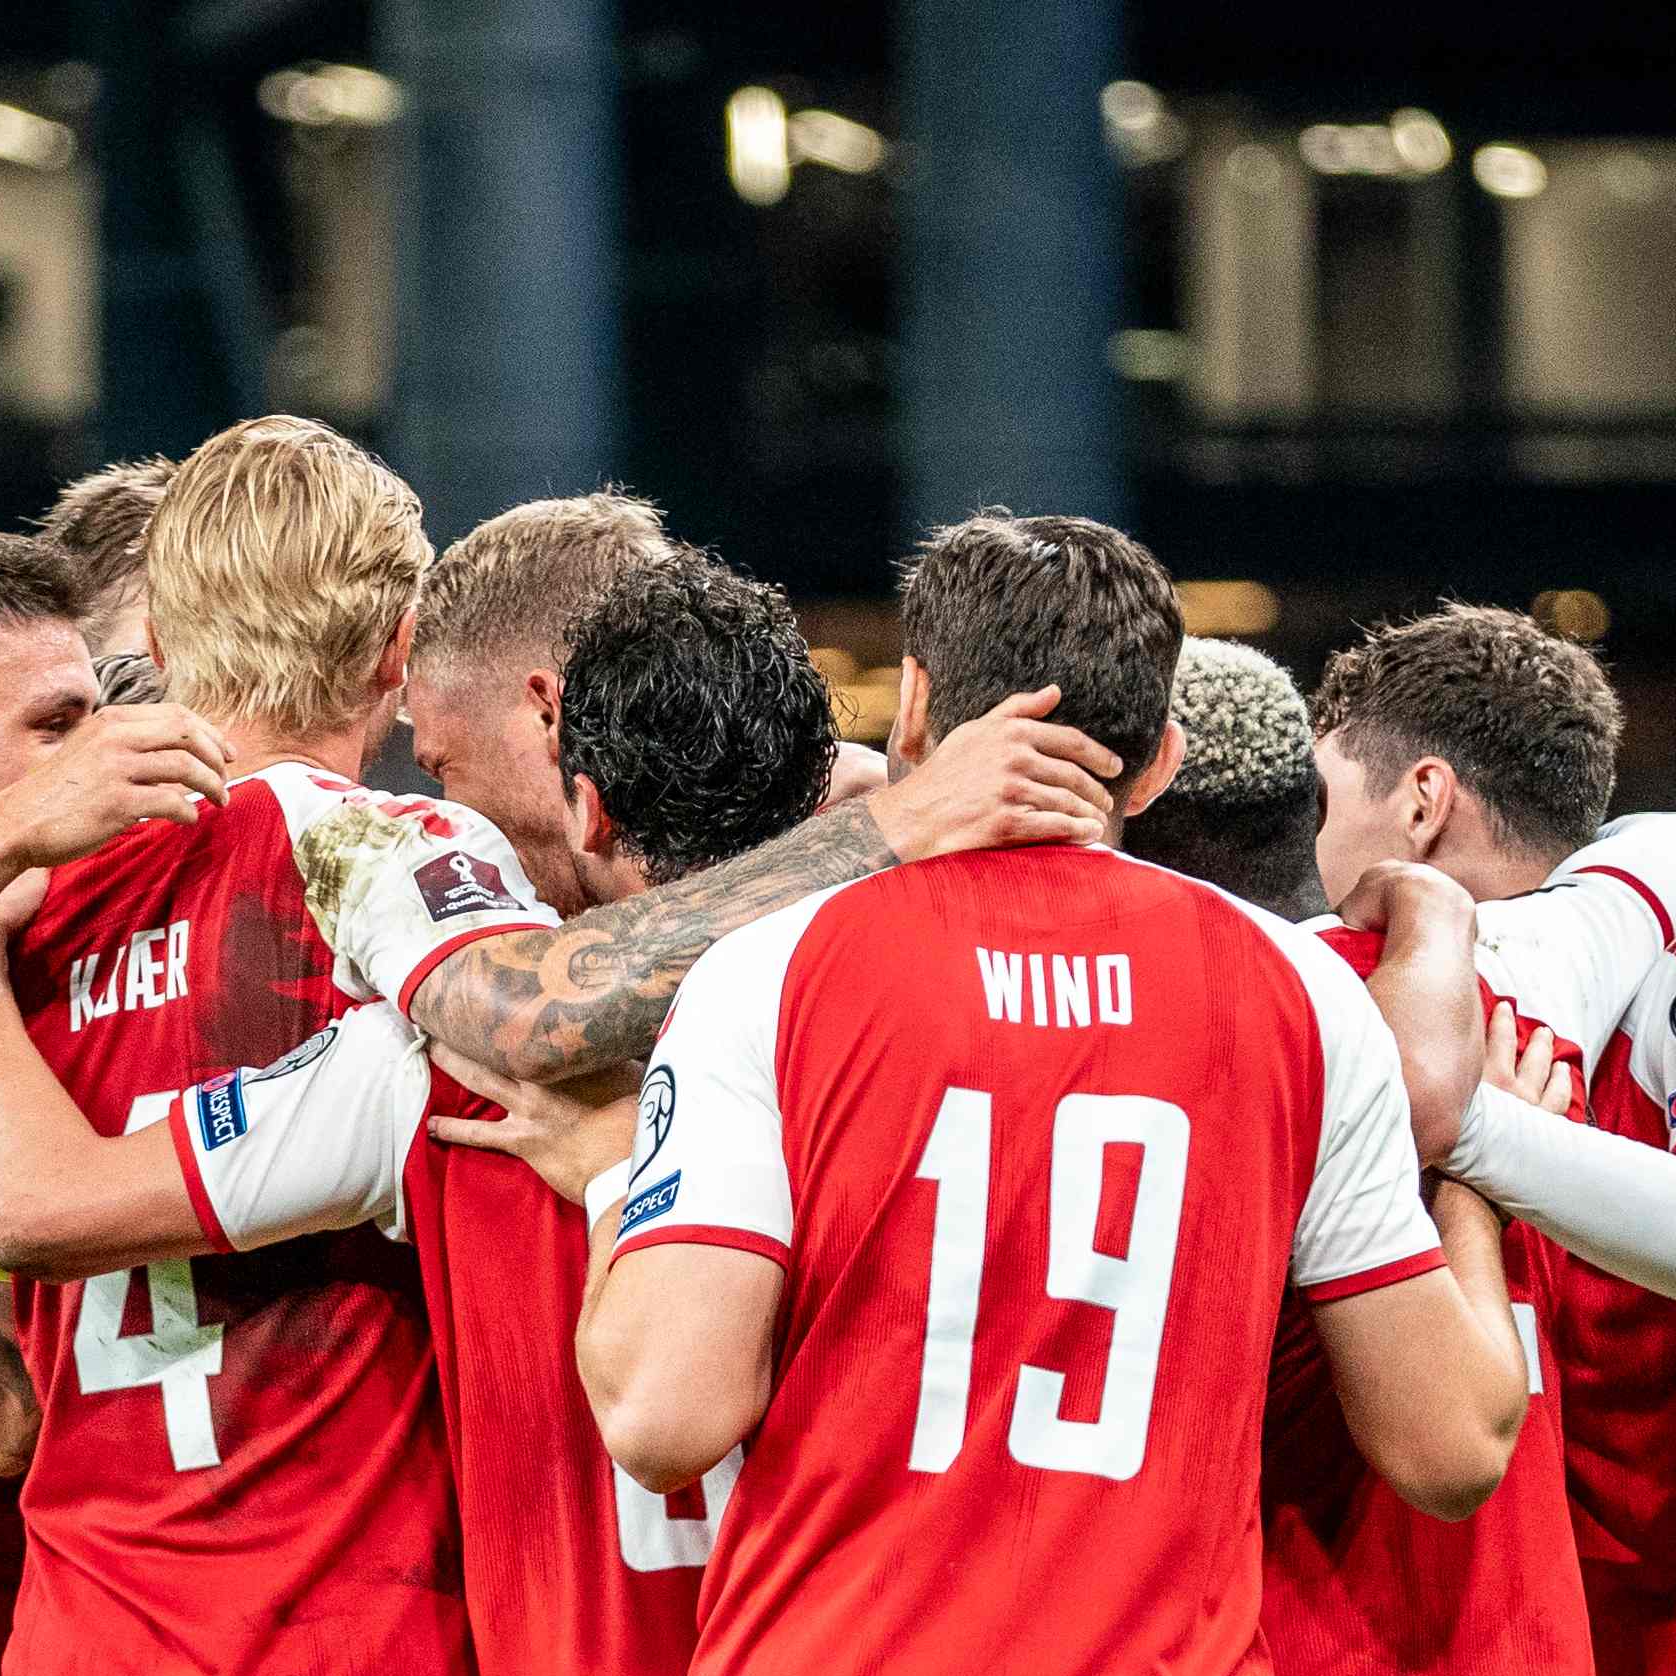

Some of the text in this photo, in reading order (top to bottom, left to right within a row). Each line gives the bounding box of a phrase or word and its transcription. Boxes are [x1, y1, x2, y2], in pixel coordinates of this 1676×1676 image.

[70, 919, 190, 1032] KJÆR
[976, 947, 1133, 1029] WIND
[74, 1090, 224, 1472] 4
[908, 1086, 1191, 1481] 19
